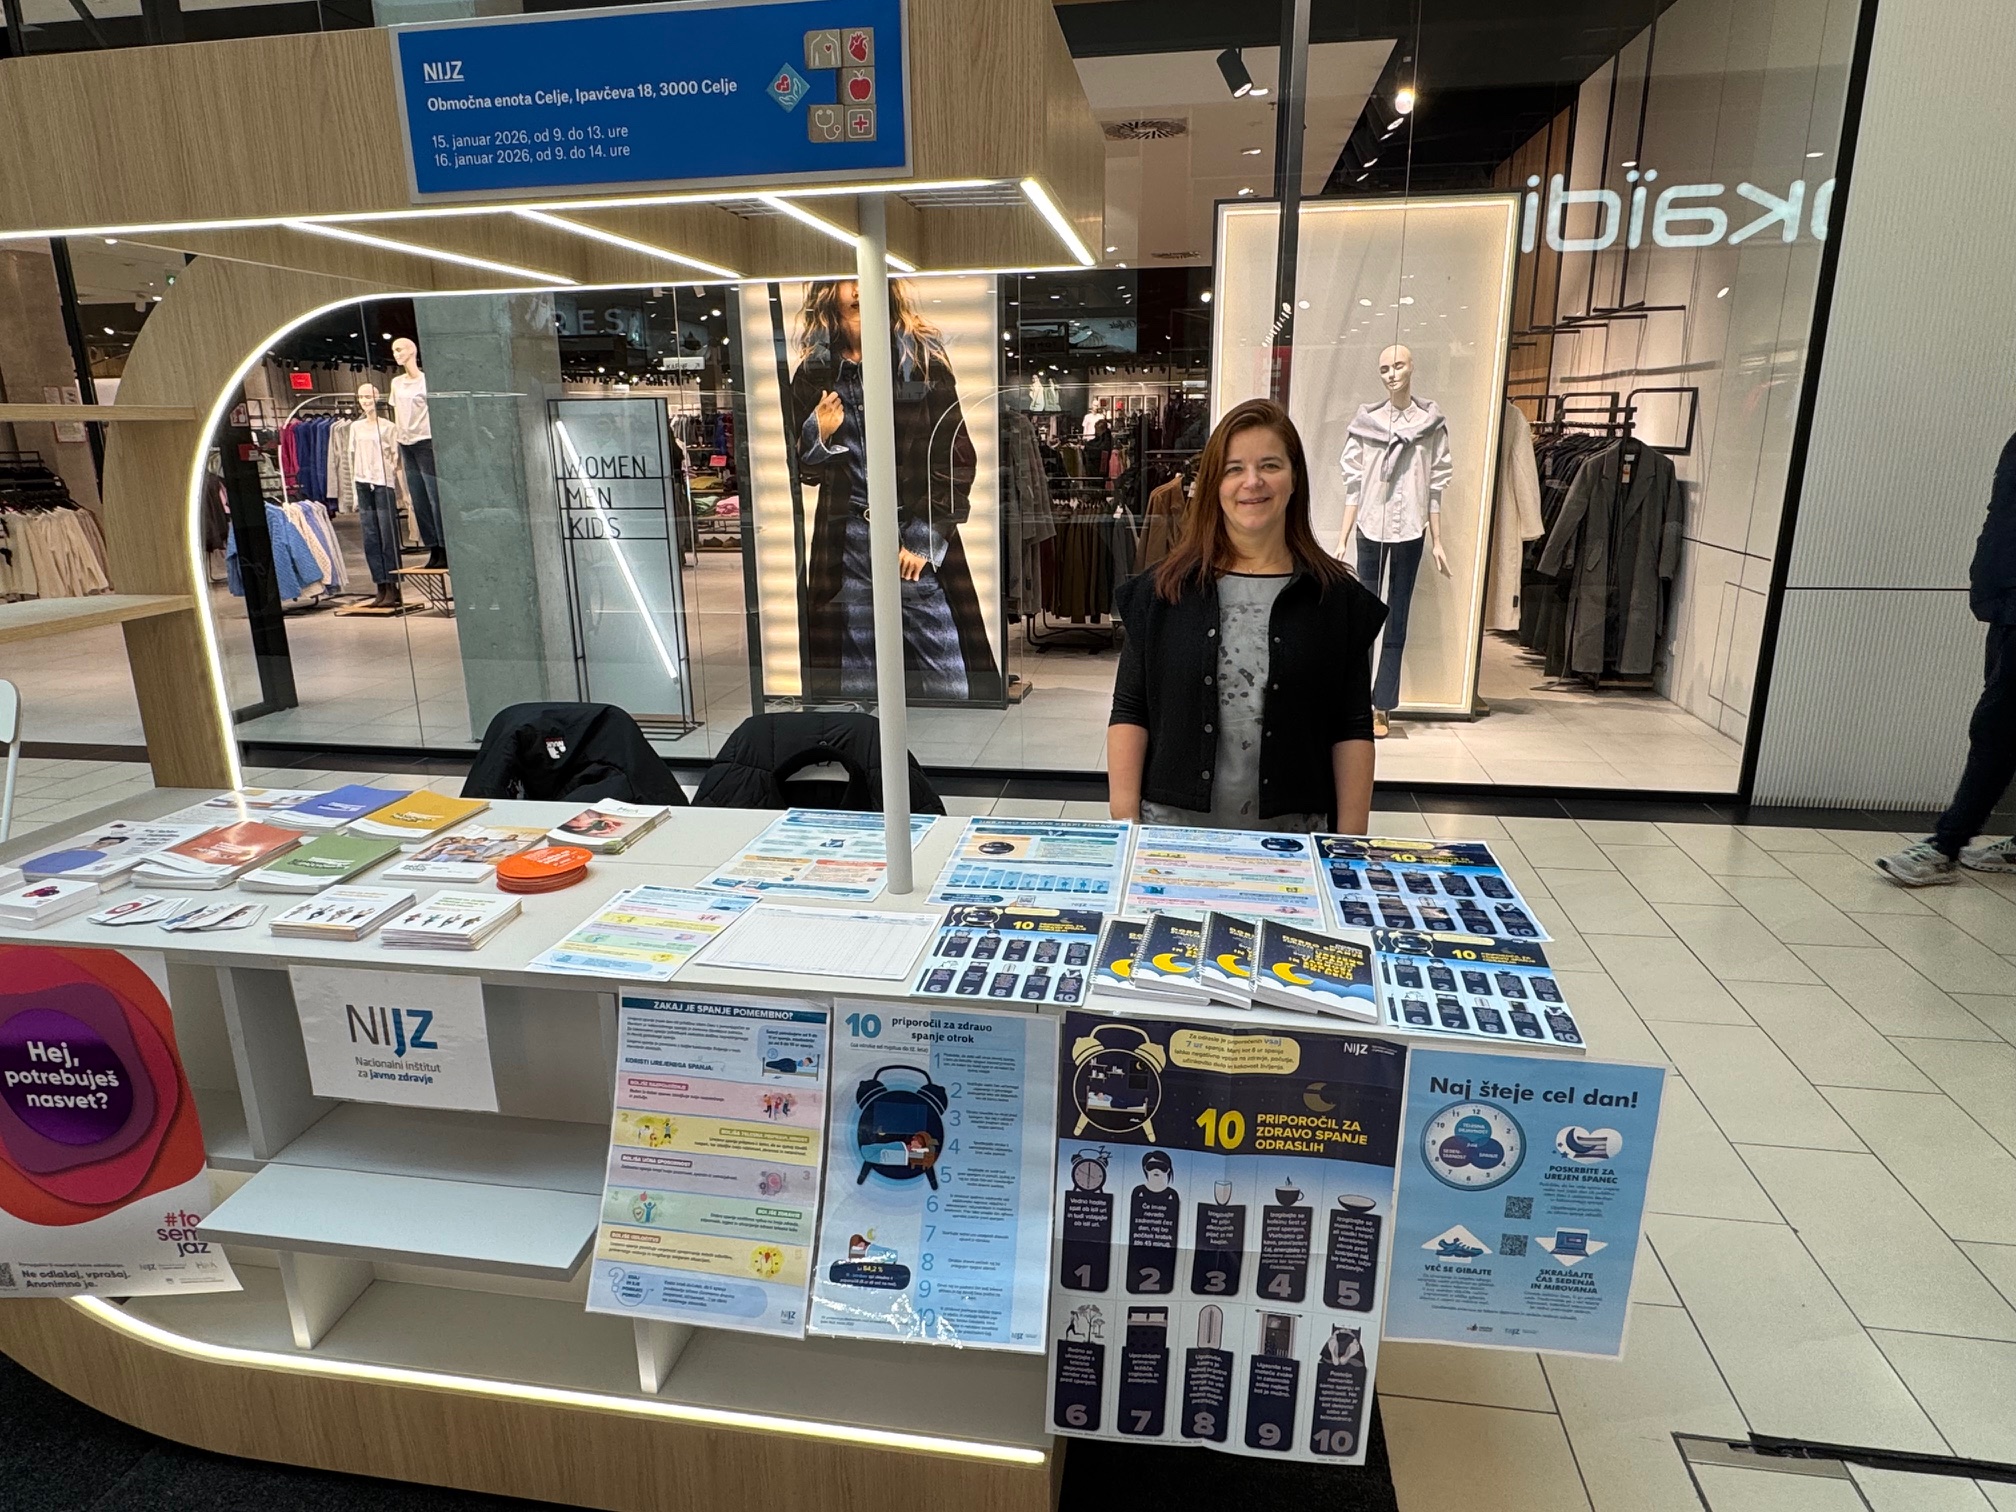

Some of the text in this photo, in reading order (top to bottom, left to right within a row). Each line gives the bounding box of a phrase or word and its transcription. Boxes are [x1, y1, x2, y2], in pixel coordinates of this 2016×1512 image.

[423, 61, 465, 82] NIJZ
[427, 78, 737, 112] Območna enota Celje, Ipavčeva 18, 3000 Celje
[432, 126, 629, 150] 15. januar 2026, od 9. do 13. ure
[434, 144, 631, 169] 16. januar 2026, od 9. do 14. ure
[563, 455, 647, 478] WOMEN
[567, 487, 612, 507] MEN
[570, 517, 621, 538] KIDS
[1391, 853, 1417, 863] 10
[1013, 920, 1035, 930] 10
[1507, 928, 1534, 937] 10
[1451, 949, 1477, 960] 10
[930, 984, 942, 992] 6
[963, 986, 975, 994] 7
[1028, 991, 1040, 999] 9
[1056, 994, 1076, 1002] 10
[1437, 983, 1450, 991] 2
[653, 1001, 793, 1020] ZAKAJ JE SPANJE POMEMBNO?
[345, 1004, 438, 1058] NIJZ
[845, 1012, 882, 1038] 10
[891, 1016, 992, 1032] priporočil za zdravo
[1411, 1015, 1579, 1042] 6 7 8 9 10
[911, 1031, 974, 1044] spanje otrok
[26, 1040, 79, 1068] Hej,
[1343, 1042, 1368, 1055] NIJZ
[355, 1056, 441, 1073] Nacionalni inštitut
[625, 1057, 650, 1065] KORISTI
[933, 1053, 940, 1068] 1
[4, 1068, 119, 1090] potrebuješ
[358, 1069, 433, 1085] za javno zdravje
[950, 1082, 962, 1099] 2
[1429, 1077, 1639, 1108] Naj šteje cel dan!
[26, 1092, 108, 1109] nasvet?
[949, 1110, 961, 1126] 3
[1257, 1113, 1362, 1132] PRIPOROČIL ZA
[1196, 1108, 1246, 1150] 10
[1256, 1126, 1368, 1145] ZDRAVO SPANJE
[948, 1138, 960, 1154] 4
[1255, 1138, 1324, 1153] ODRASLIH
[802, 1170, 811, 1181] 3
[940, 1166, 952, 1183] 5
[1544, 1173, 1618, 1184] UREJEN SPANEC
[1549, 1165, 1615, 1176] POSKRBITE ZA
[926, 1195, 938, 1213] 6
[164, 1209, 202, 1227] #to
[925, 1225, 936, 1242] 7
[177, 1242, 211, 1257] jaz
[921, 1253, 934, 1271] 8
[1424, 1263, 1441, 1272] VEČ
[1455, 1266, 1492, 1276] GIBAJTE
[22, 1269, 131, 1280] Ne odlašaj, vprašaj.
[1535, 1274, 1595, 1287] ČAS SEDENJA
[1540, 1268, 1594, 1279] SKRAJŠAJTE
[26, 1280, 98, 1289] Anonimno je.
[919, 1280, 931, 1298] 9
[1074, 1264, 1361, 1306] 1 2 3 4 5
[1543, 1284, 1598, 1294] MIROVANJA
[1065, 1404, 1354, 1453] 6 7 8 9 10
